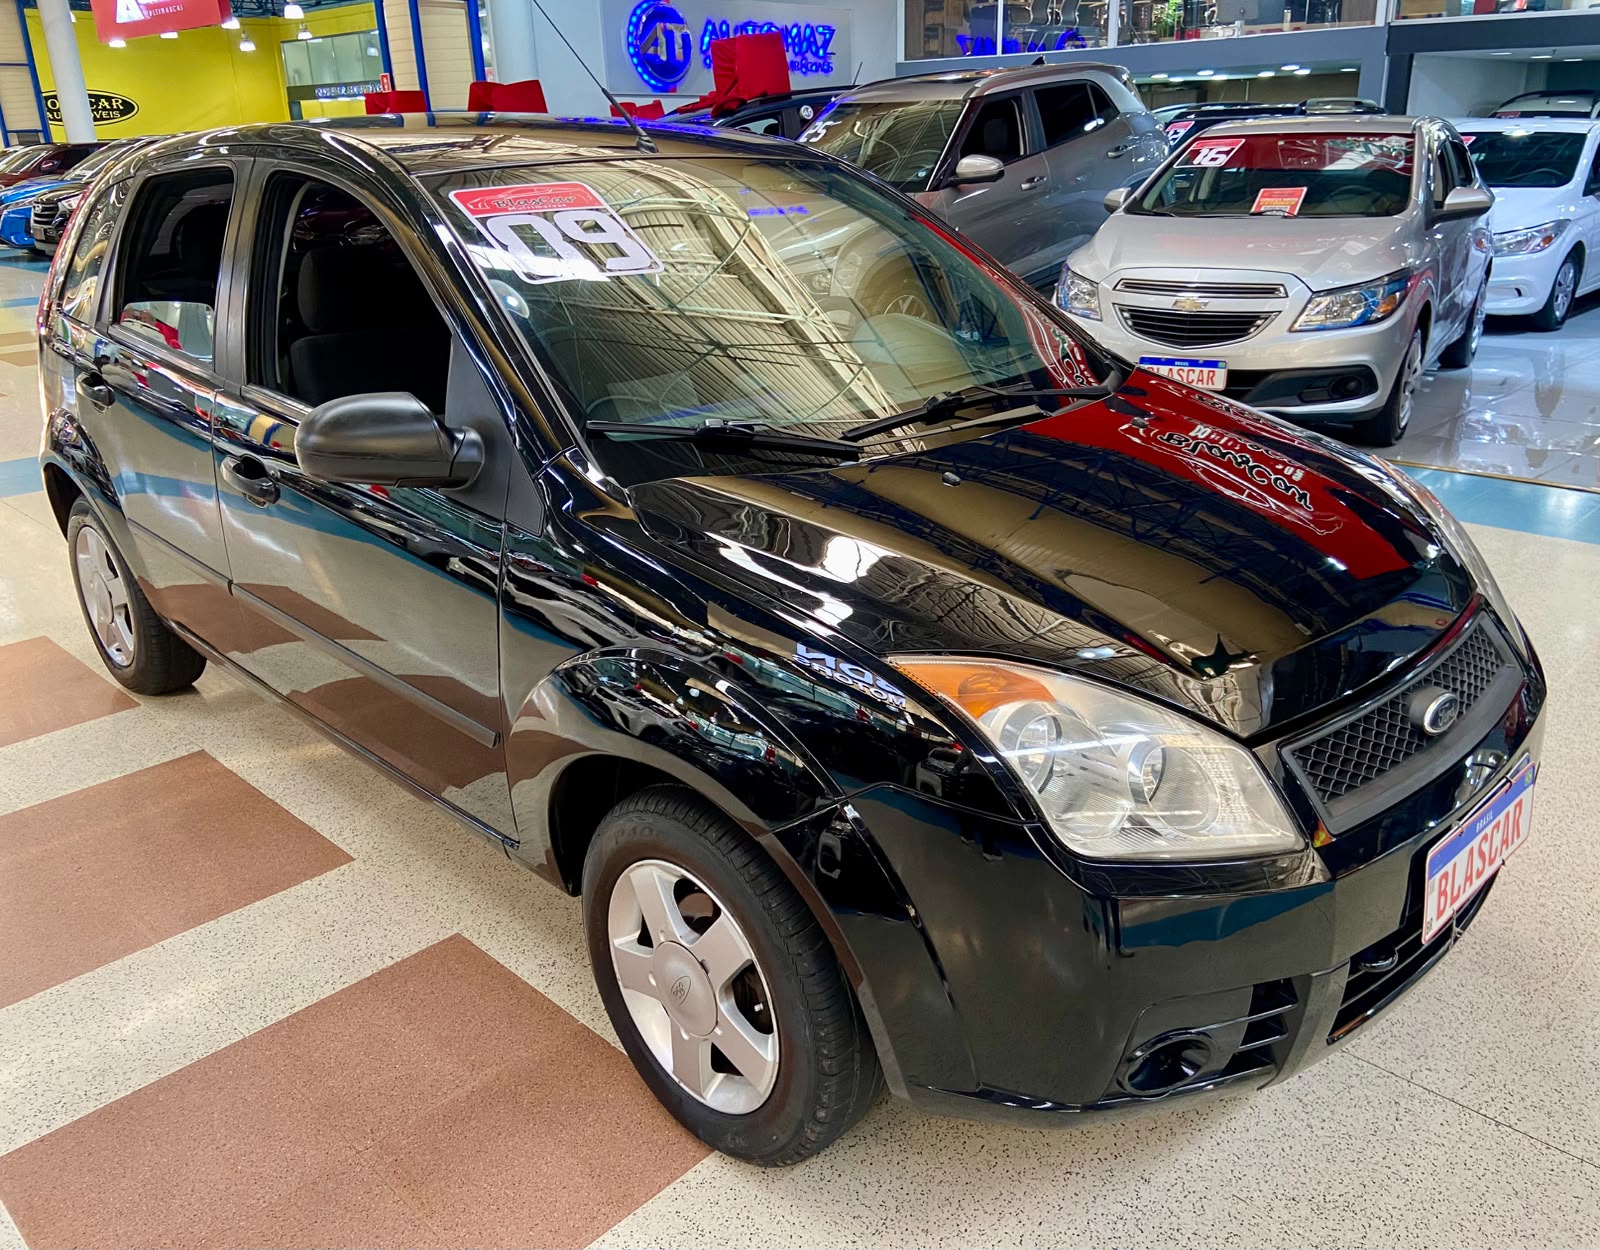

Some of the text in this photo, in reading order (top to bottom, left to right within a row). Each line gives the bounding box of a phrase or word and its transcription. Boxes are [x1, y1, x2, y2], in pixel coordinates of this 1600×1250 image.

[1192, 146, 1231, 165] 16
[493, 195, 576, 208] BlasCar
[487, 210, 650, 277] 09
[1476, 811, 1493, 833] BRASIL
[1436, 798, 1523, 921] BLASCAR
